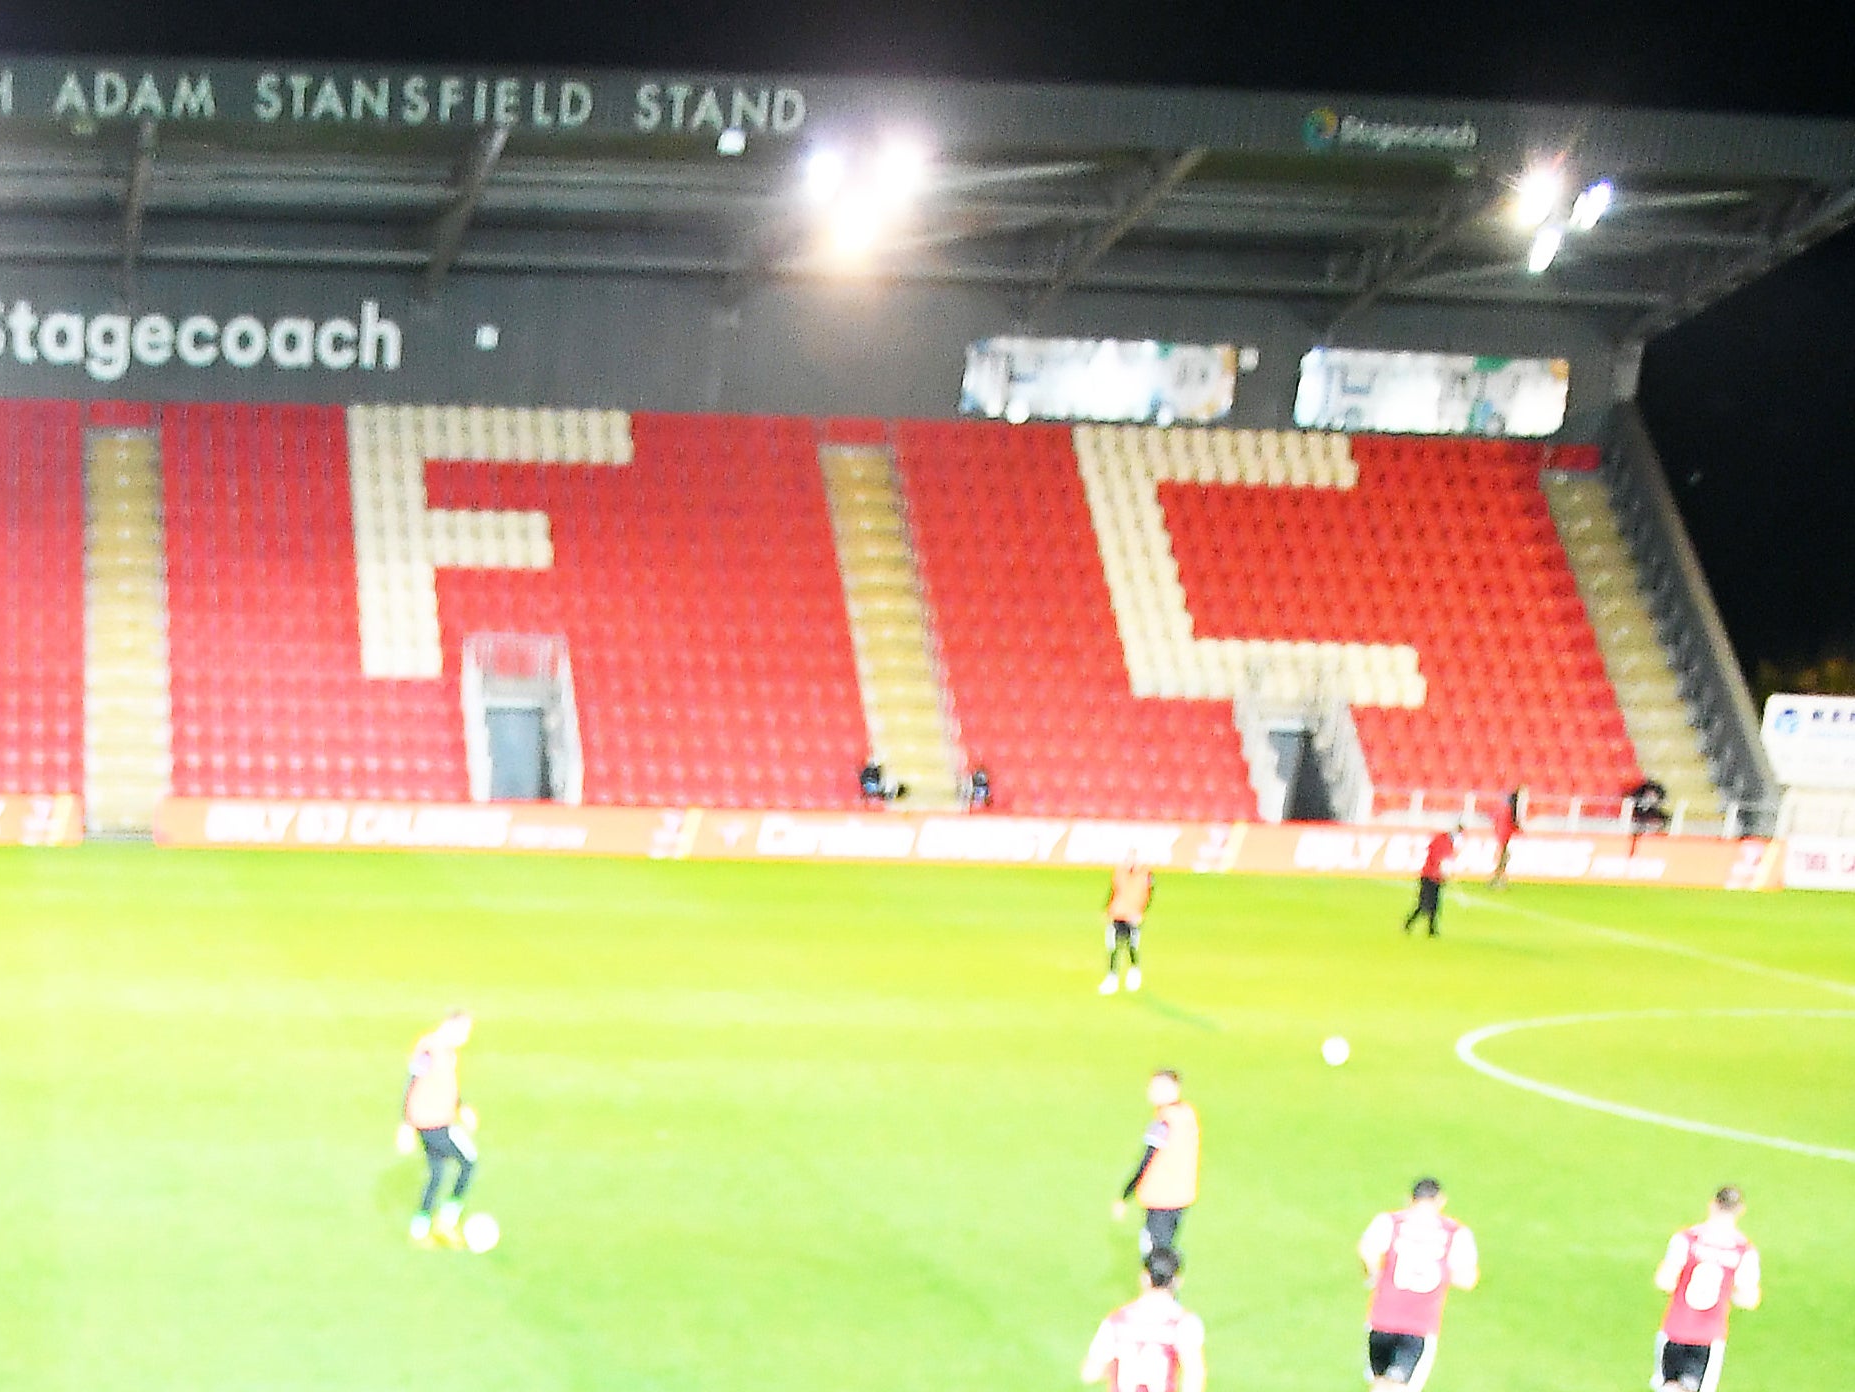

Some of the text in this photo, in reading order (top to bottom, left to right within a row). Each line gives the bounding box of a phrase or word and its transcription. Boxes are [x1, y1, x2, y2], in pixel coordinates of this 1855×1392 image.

[55, 68, 216, 119] ADAM
[254, 72, 593, 126] STANSFIELD
[633, 83, 807, 133] STAND
